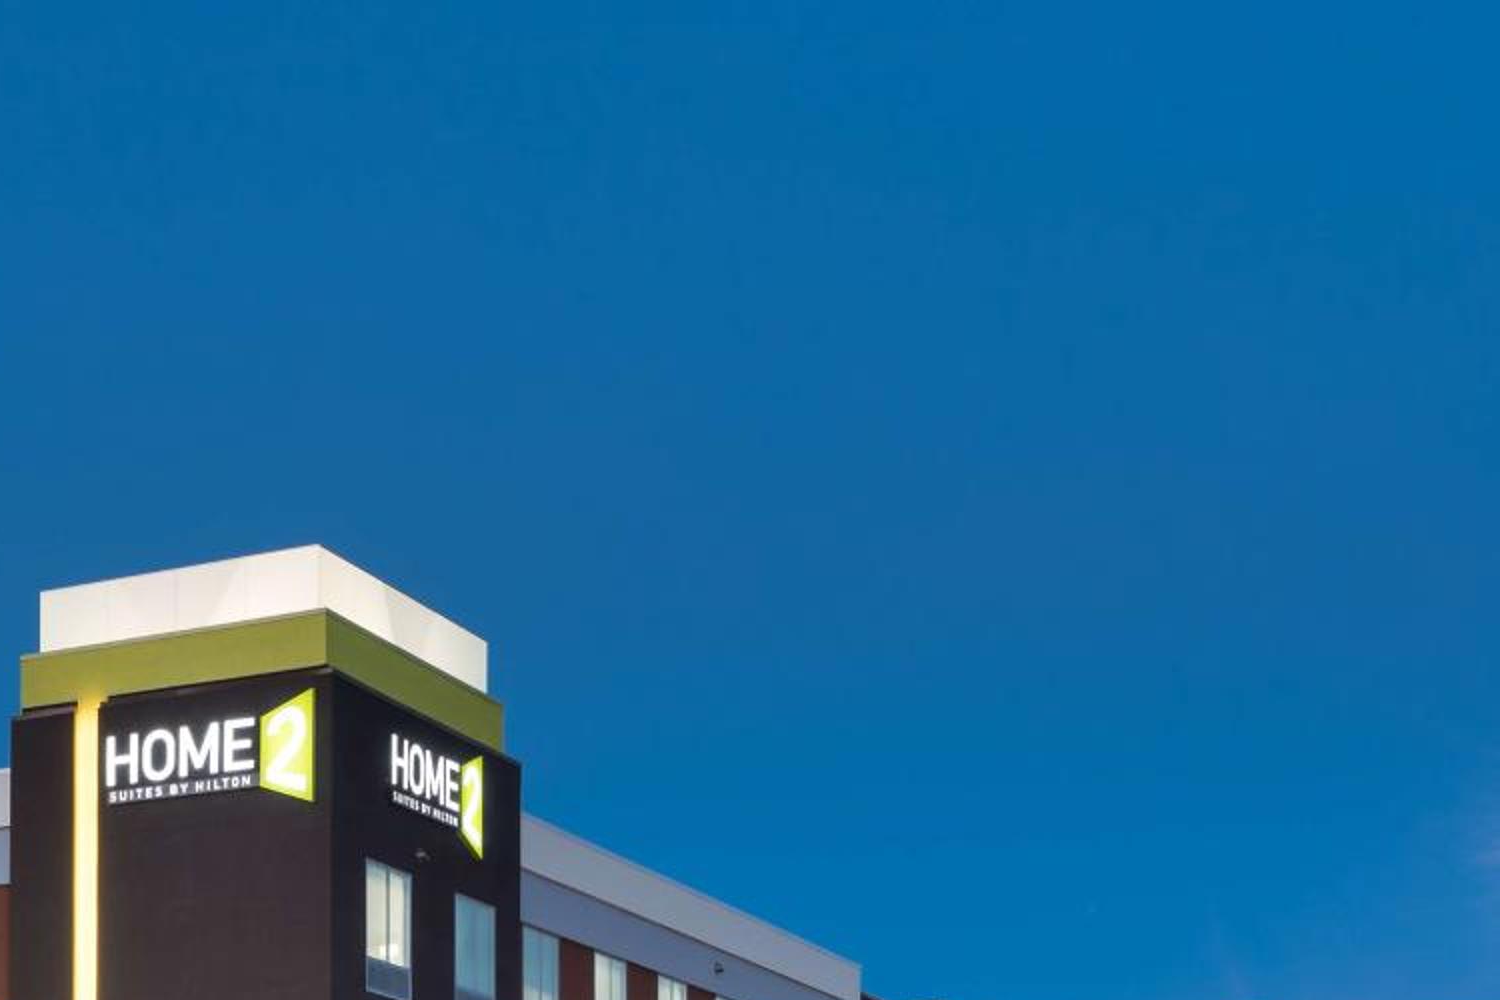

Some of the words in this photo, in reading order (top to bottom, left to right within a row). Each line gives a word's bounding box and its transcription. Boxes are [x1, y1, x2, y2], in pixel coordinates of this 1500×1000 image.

[109, 786, 163, 804] SUITES
[169, 781, 189, 796] BY
[195, 773, 253, 794] HILTON
[421, 802, 432, 816] BY
